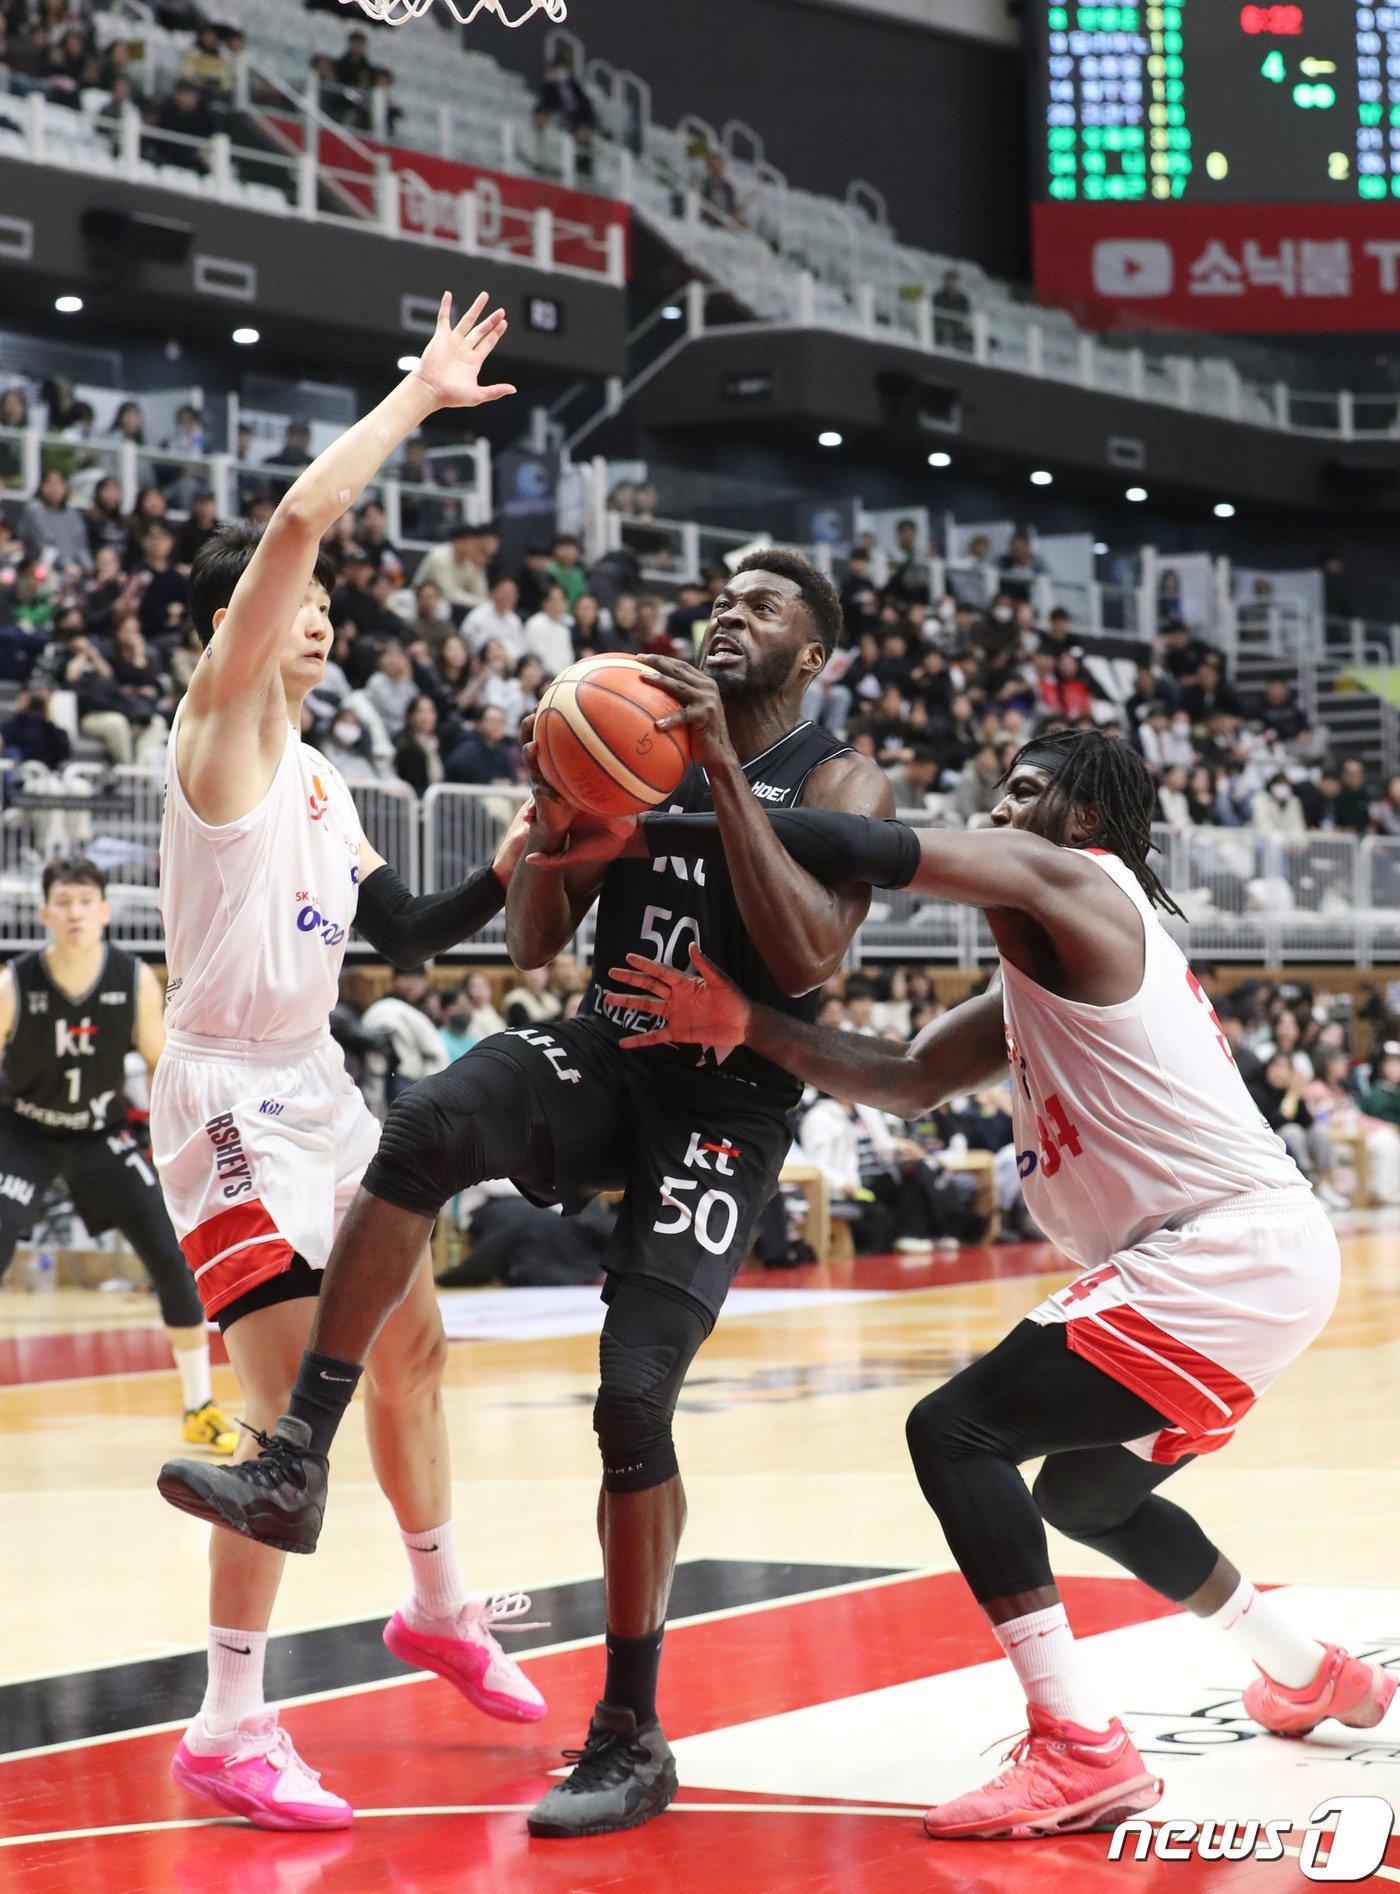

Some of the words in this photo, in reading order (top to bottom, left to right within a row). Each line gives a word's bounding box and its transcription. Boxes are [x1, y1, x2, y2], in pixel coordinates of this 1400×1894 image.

[55, 1016, 97, 1057] kt
[64, 1067, 81, 1104] 1
[683, 1132, 741, 1176] kt
[653, 1176, 738, 1255] 50
